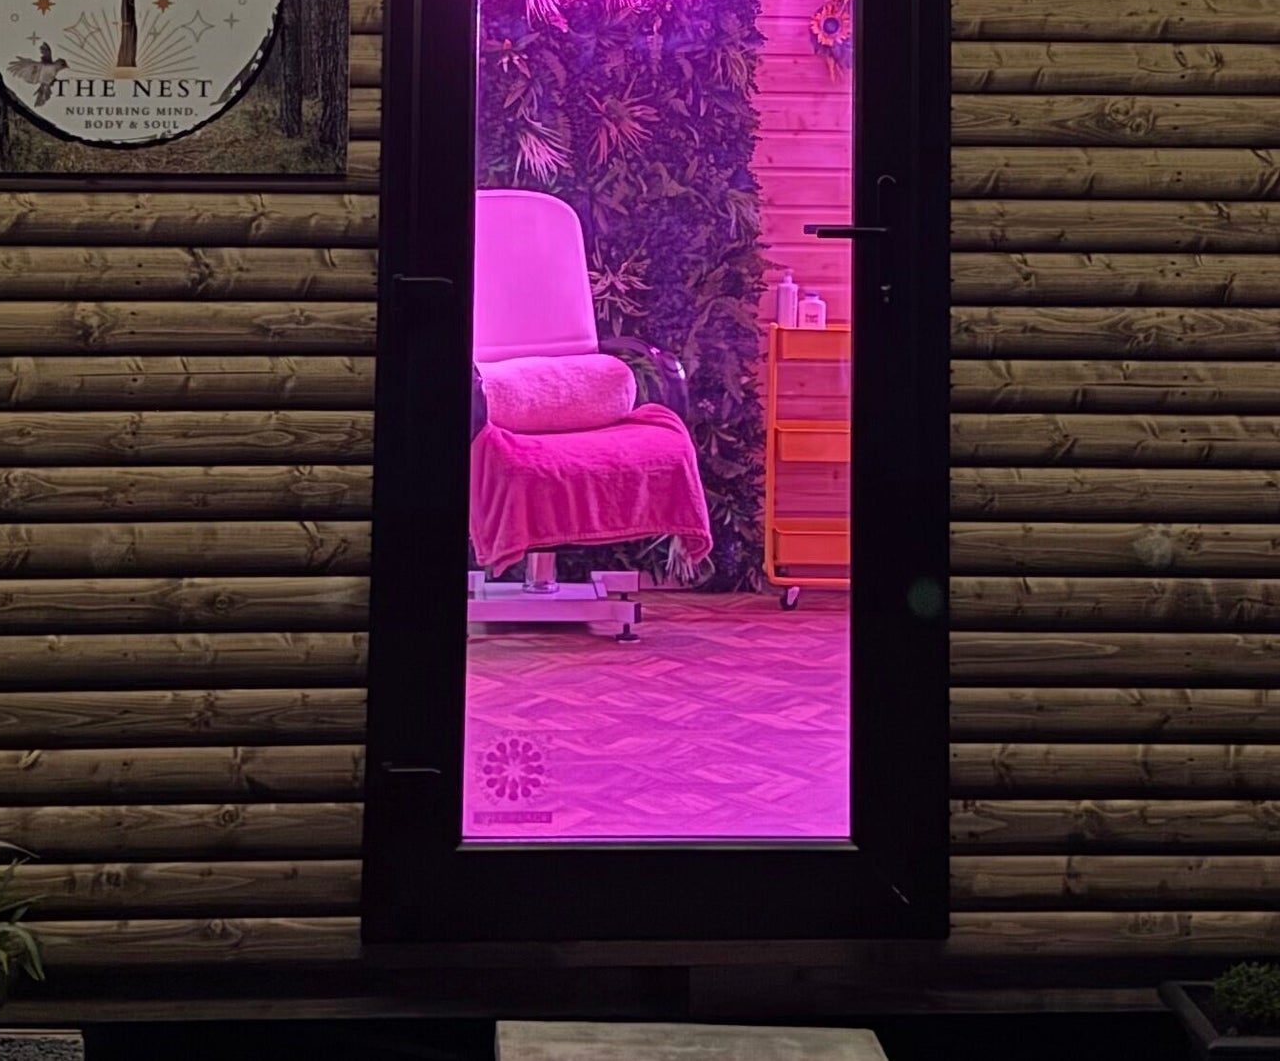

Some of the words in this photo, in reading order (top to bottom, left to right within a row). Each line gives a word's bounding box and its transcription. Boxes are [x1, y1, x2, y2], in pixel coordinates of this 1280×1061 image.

[55, 79, 117, 98] THE
[132, 79, 213, 98] NEST
[65, 106, 150, 117] NURTURING
[84, 119, 124, 130] BODY
[129, 120, 138, 130] &
[144, 119, 180, 130] SOUL
